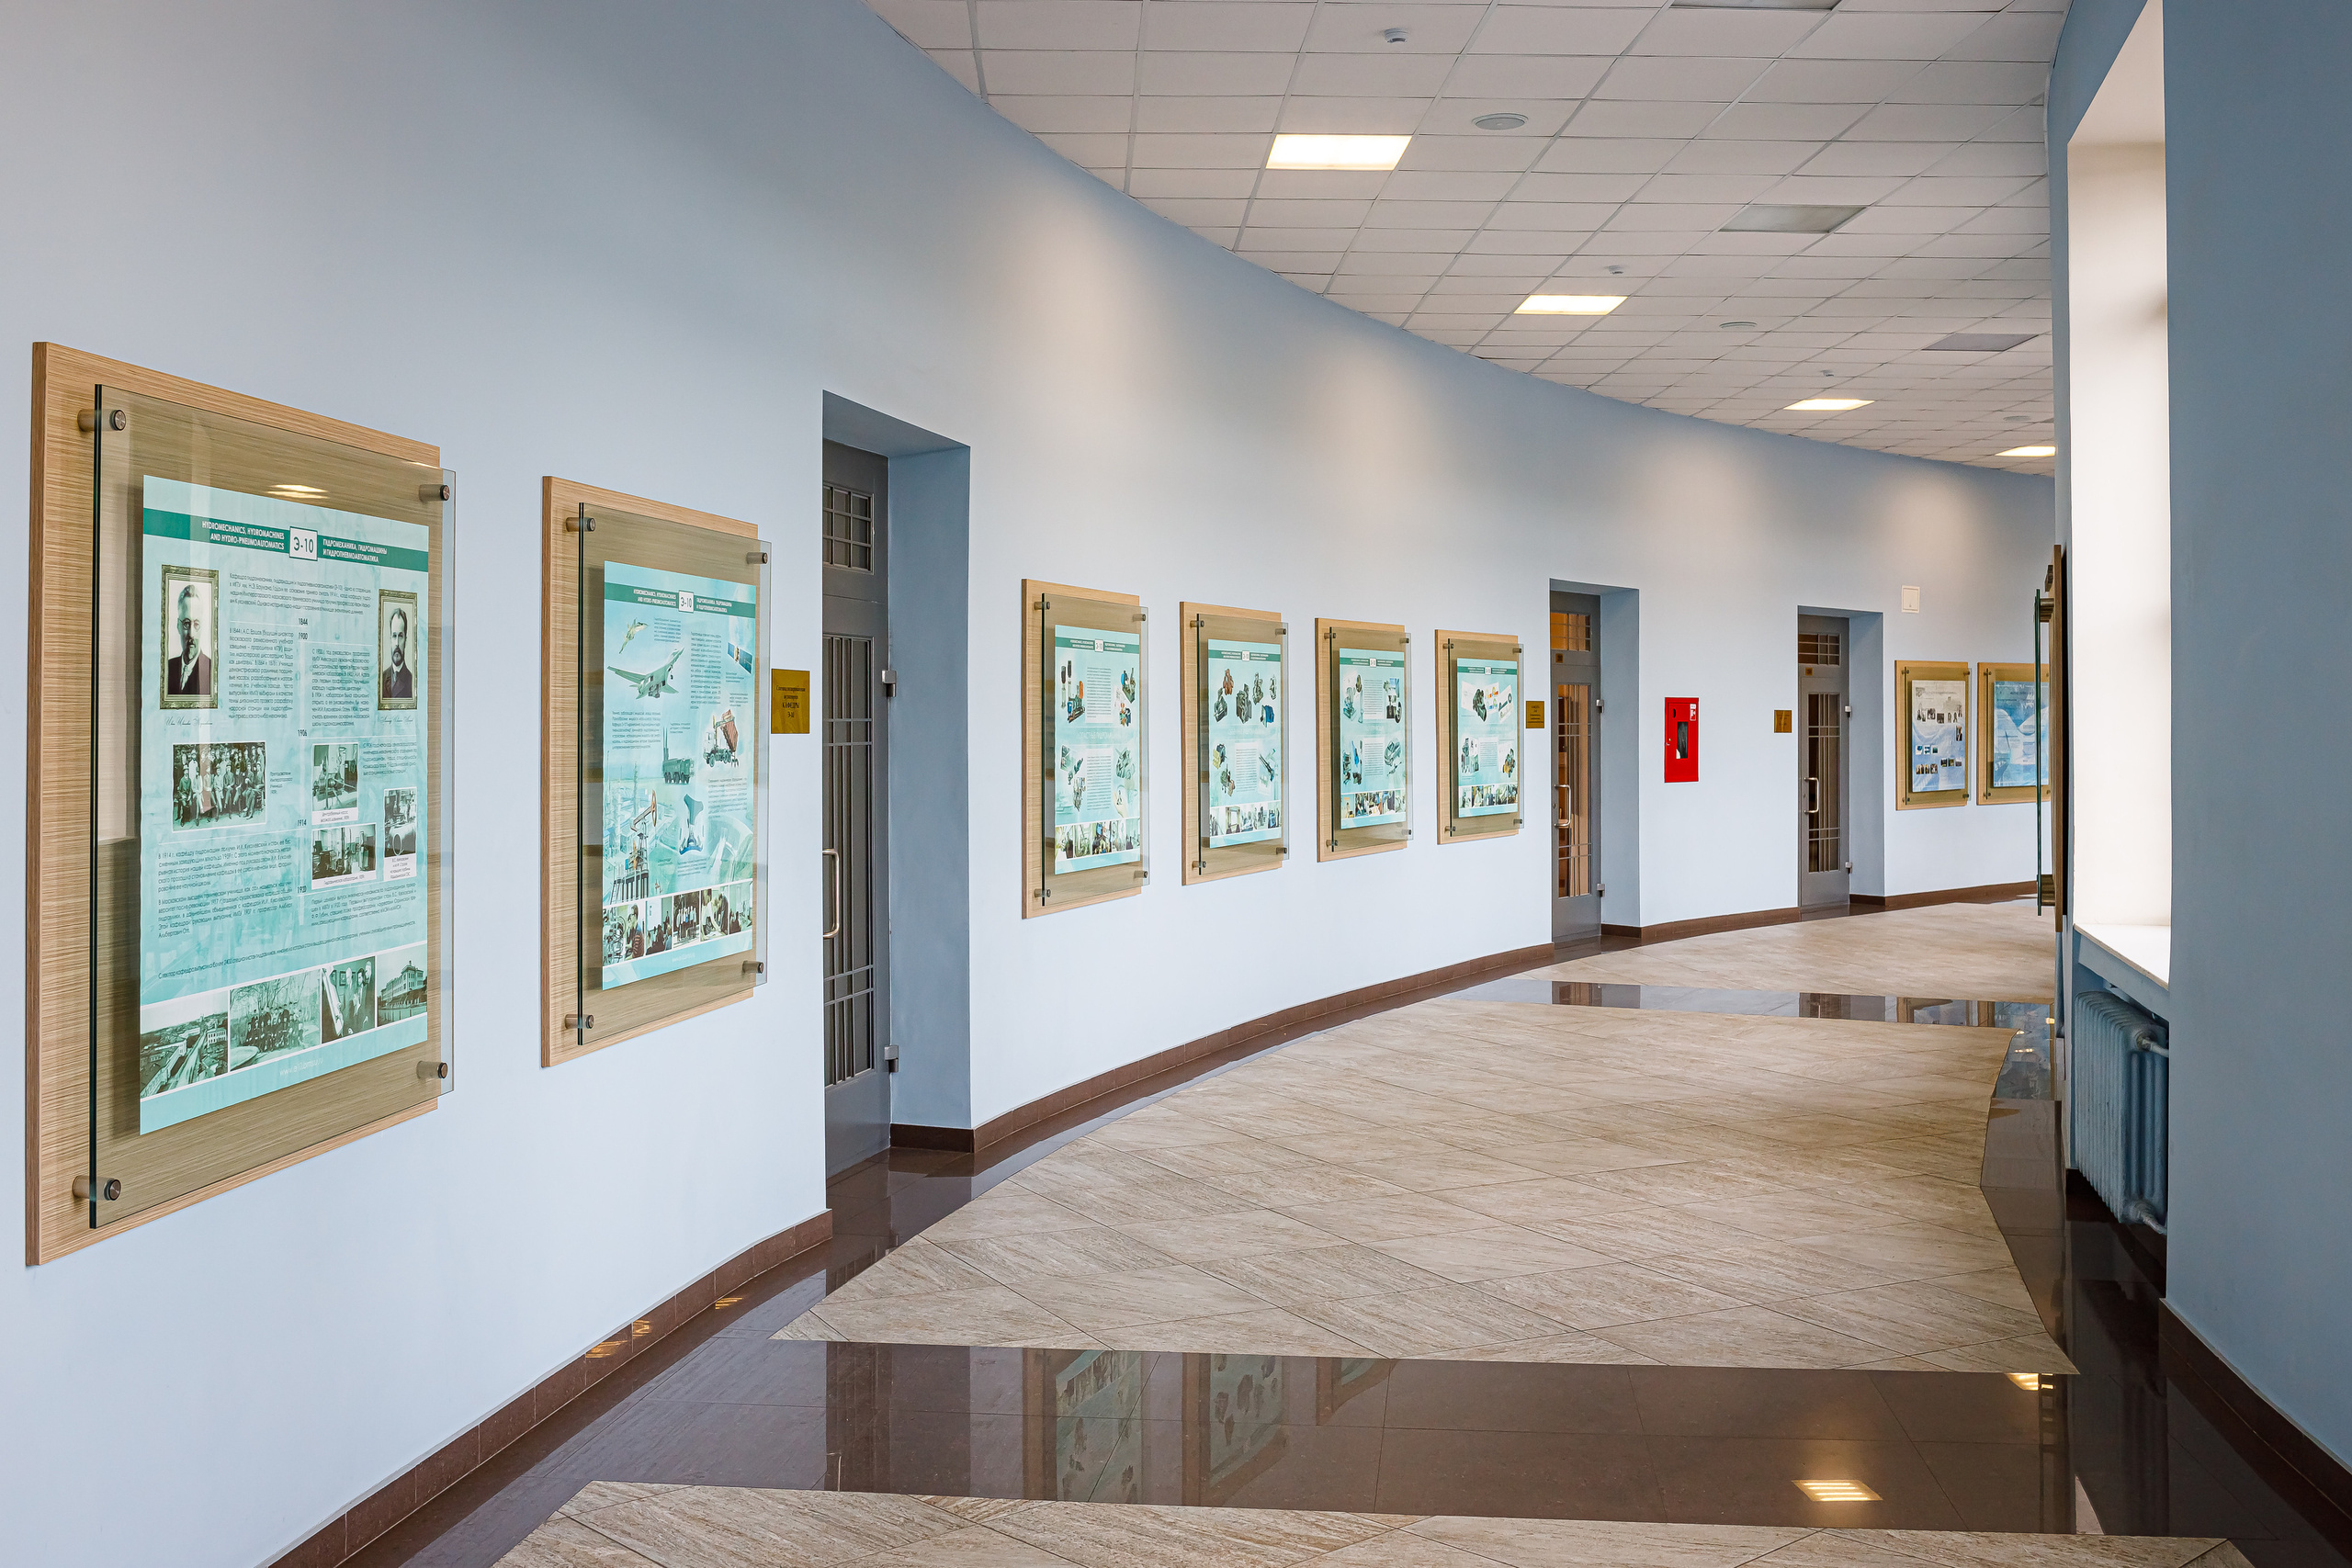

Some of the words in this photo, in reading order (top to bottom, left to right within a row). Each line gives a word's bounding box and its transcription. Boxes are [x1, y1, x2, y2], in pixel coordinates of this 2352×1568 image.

[210, 533, 220, 541] AND
[293, 536, 313, 553] Э-10
[681, 597, 692, 608] Э-10
[299, 617, 309, 626] 1844
